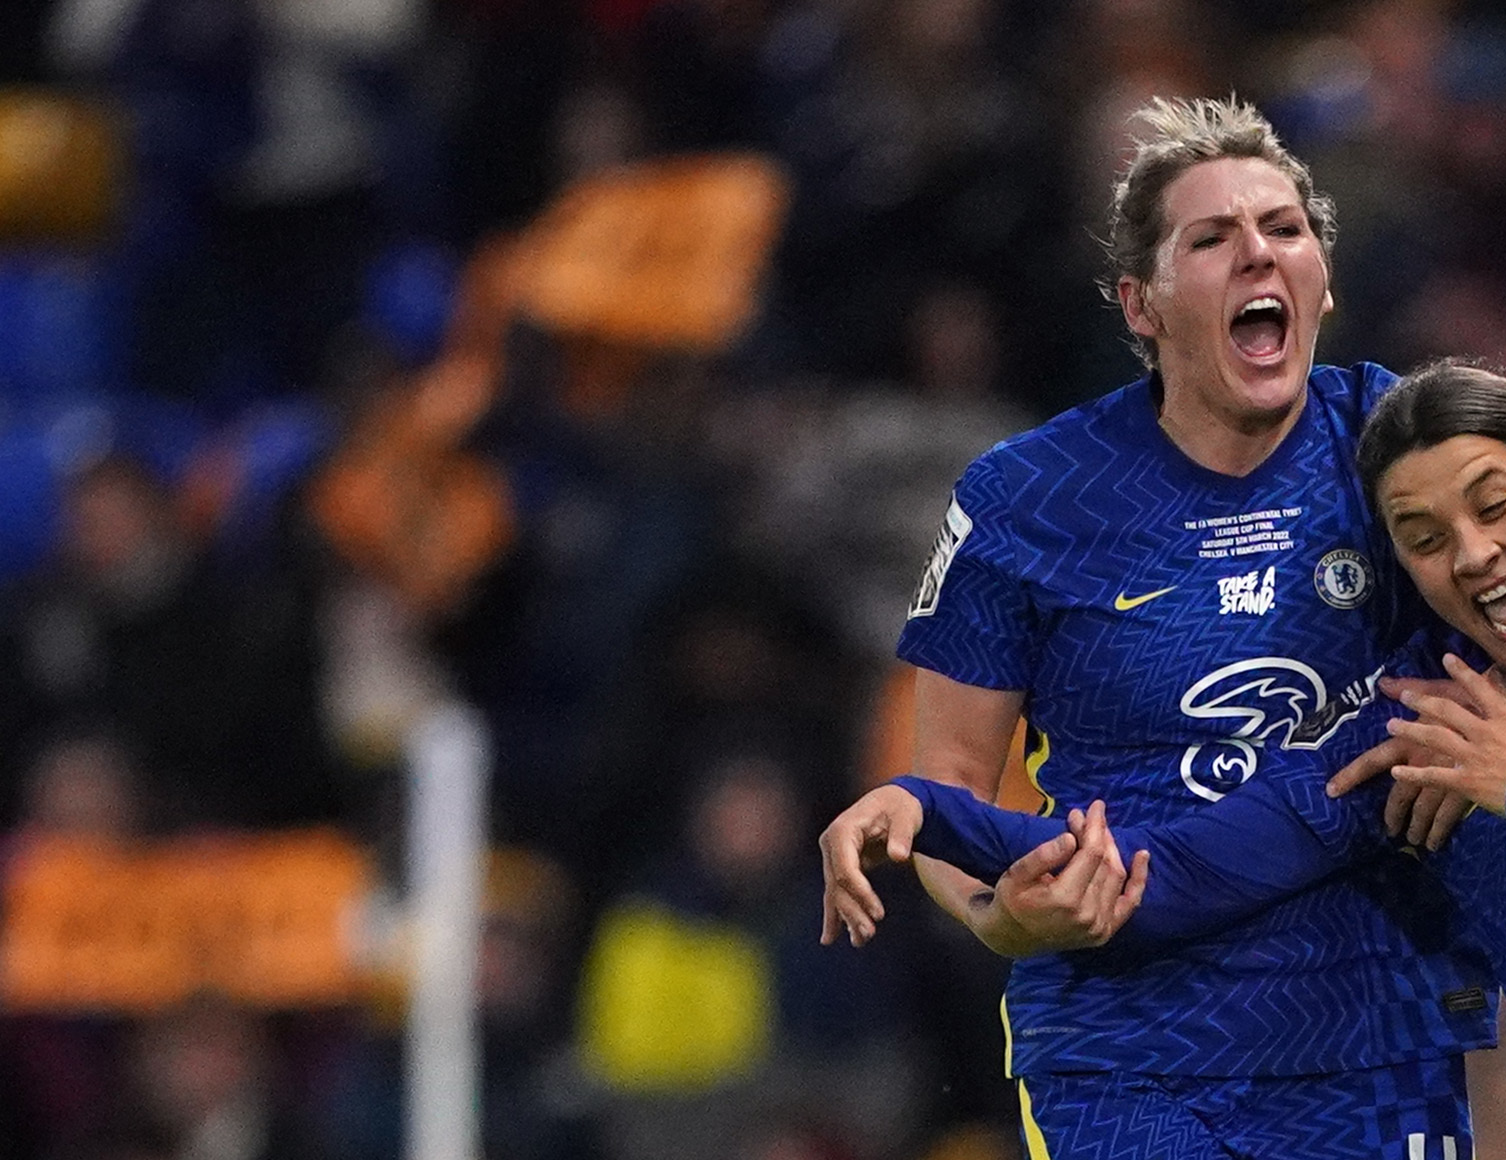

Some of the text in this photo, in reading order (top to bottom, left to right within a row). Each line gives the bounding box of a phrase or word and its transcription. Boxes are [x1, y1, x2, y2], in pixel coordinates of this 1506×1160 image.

[1184, 521, 1197, 530] THE
[1239, 509, 1281, 524] CONTINENTAL
[1214, 521, 1275, 538] LEAGUE CUP FINAL
[1202, 537, 1234, 549] SATURDAY
[1248, 532, 1272, 543] MARCH
[1272, 530, 1290, 541] 2022
[1198, 549, 1229, 558] CHELSEA
[1236, 542, 1279, 556] MANCHESTER
[1279, 540, 1294, 551] CITY
[1321, 551, 1360, 567] CHELSEA
[1217, 565, 1275, 596] TAKE A
